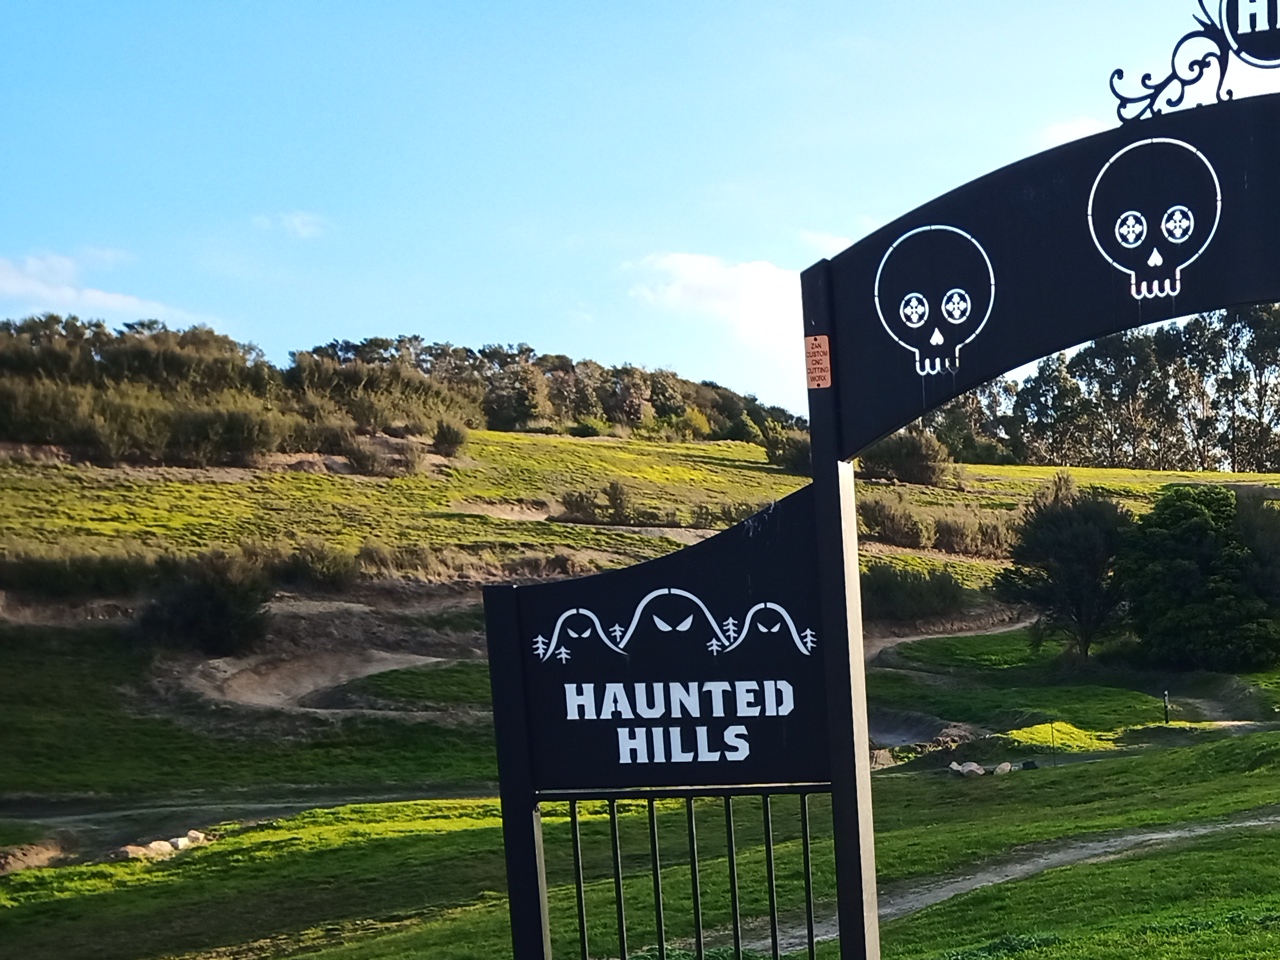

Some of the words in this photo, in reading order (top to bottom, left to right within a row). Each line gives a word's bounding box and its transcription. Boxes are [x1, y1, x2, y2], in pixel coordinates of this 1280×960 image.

[806, 350, 828, 358] CUSTOM
[807, 366, 829, 375] CUTTING
[563, 680, 795, 721] HAUNTED
[616, 725, 751, 764] HILLS
